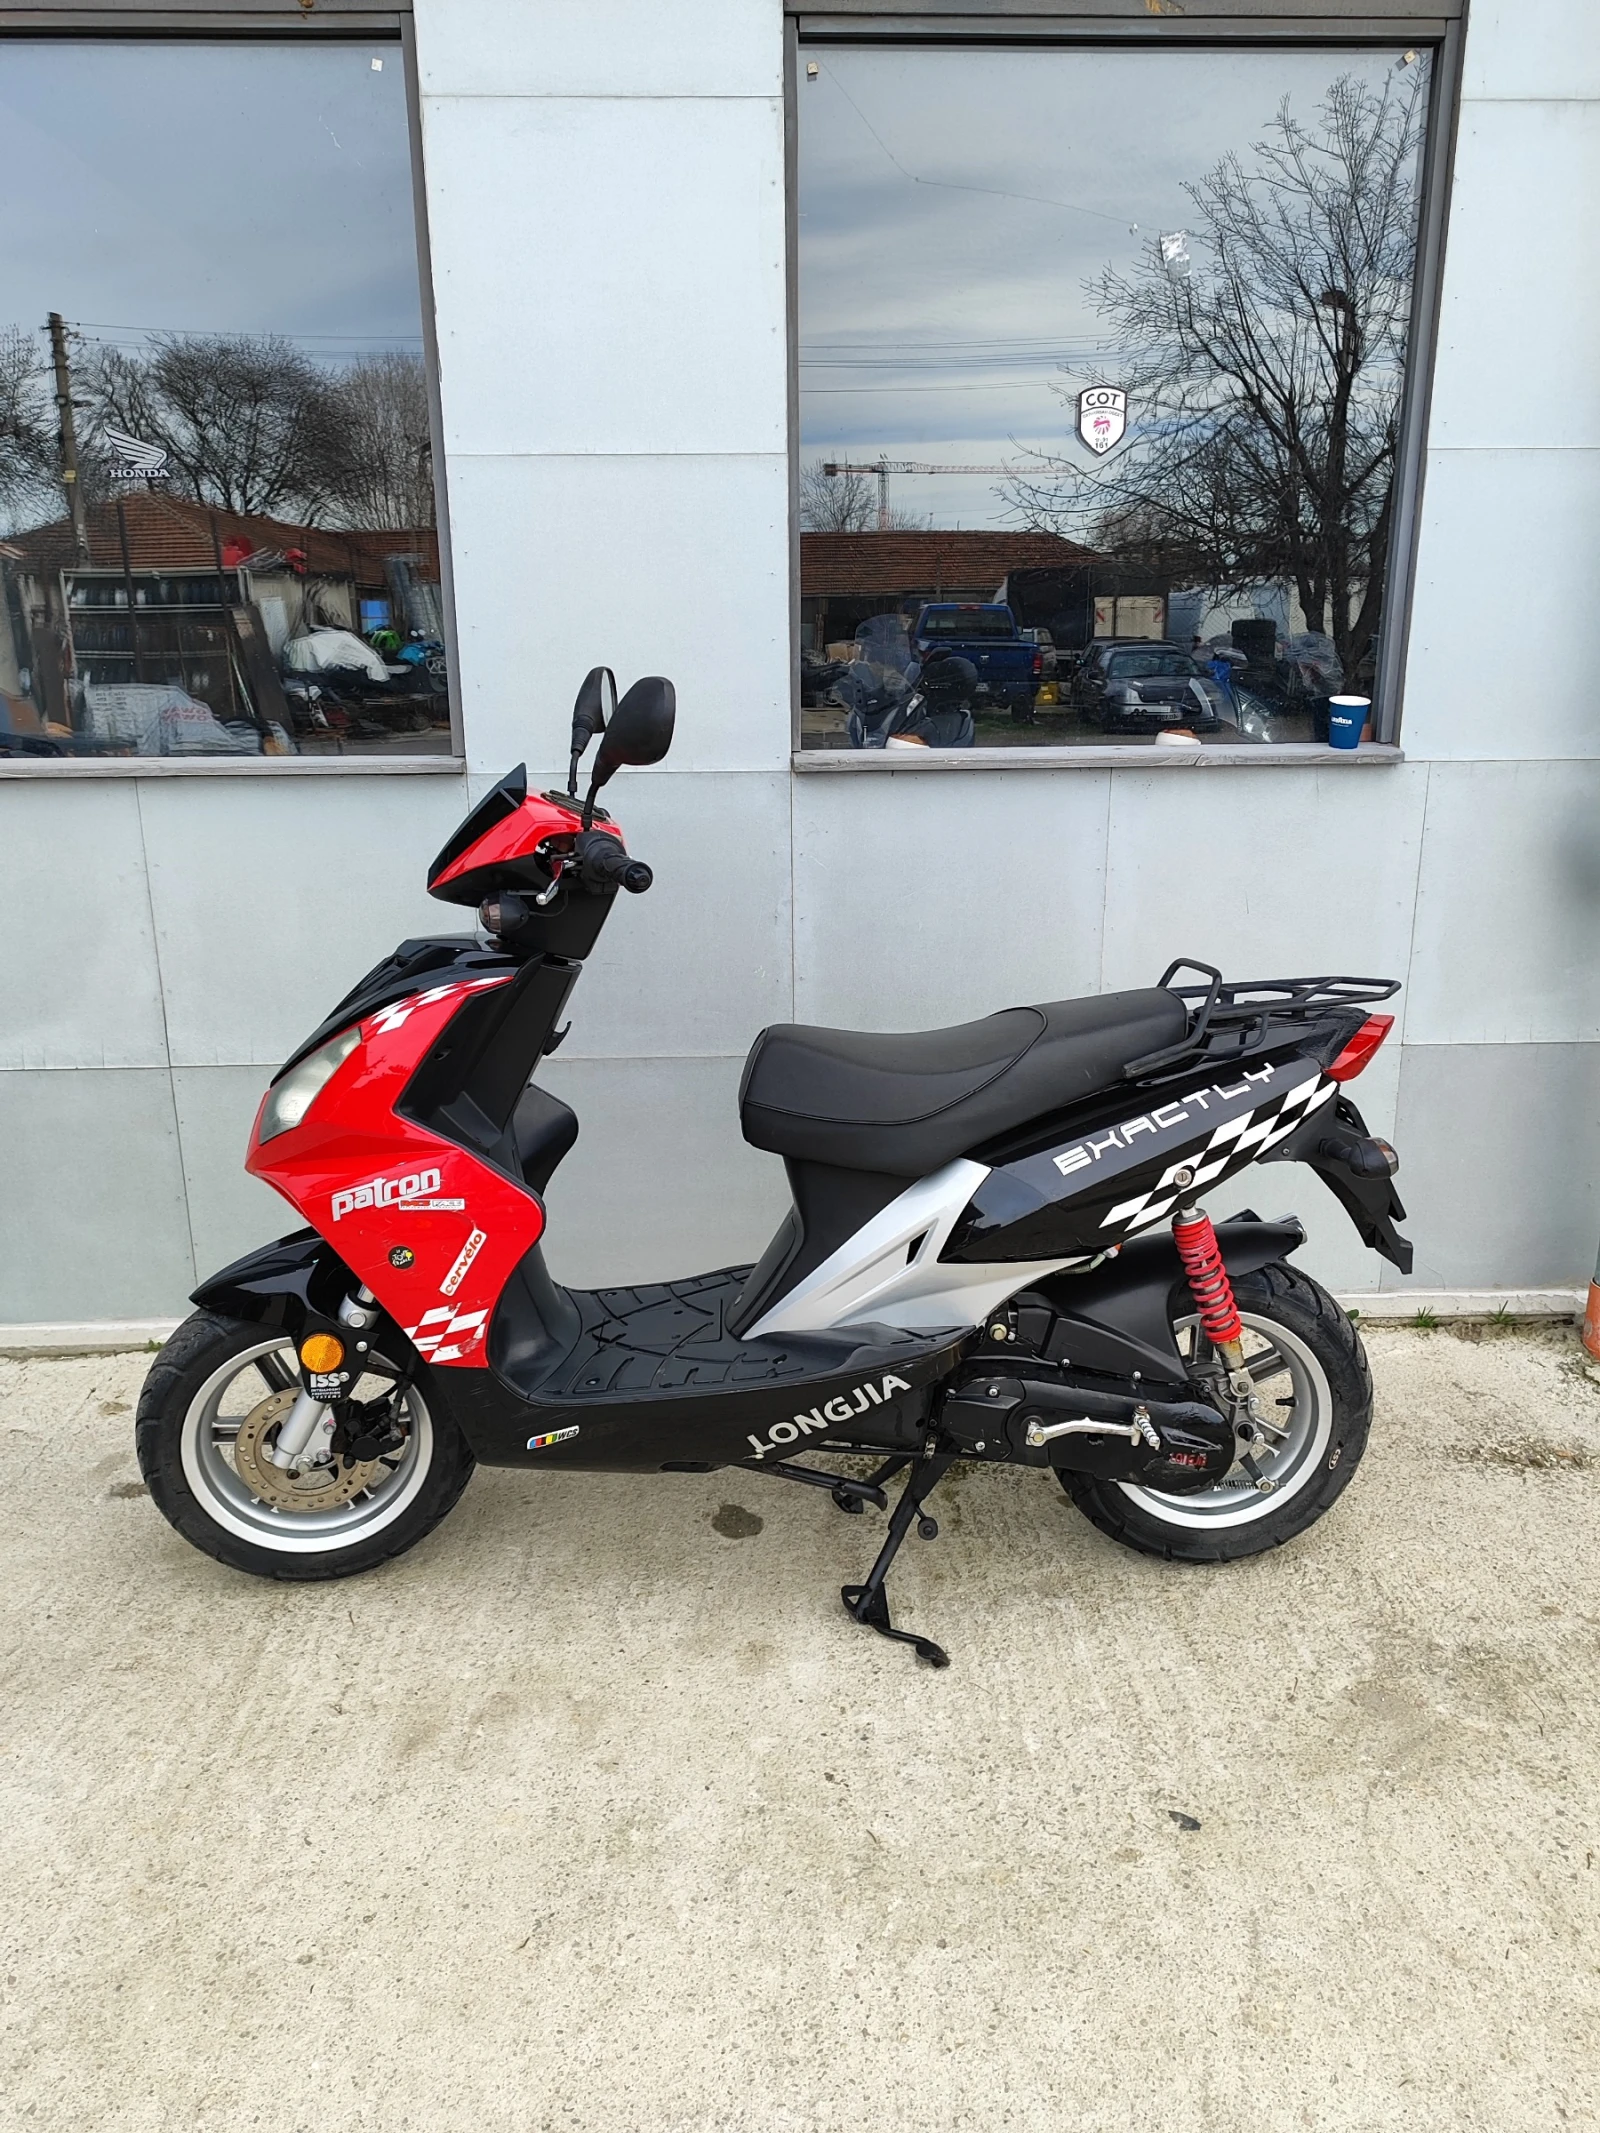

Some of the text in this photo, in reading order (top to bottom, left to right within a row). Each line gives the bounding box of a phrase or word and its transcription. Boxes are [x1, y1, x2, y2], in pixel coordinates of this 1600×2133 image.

[109, 469, 171, 478] HONDA
[1052, 1062, 1276, 1176] EXACTLY
[444, 1233, 483, 1295] cervélo
[310, 1372, 341, 1388] ISS
[747, 1374, 912, 1453] LONGJIA
[556, 1427, 579, 1441] WCS
